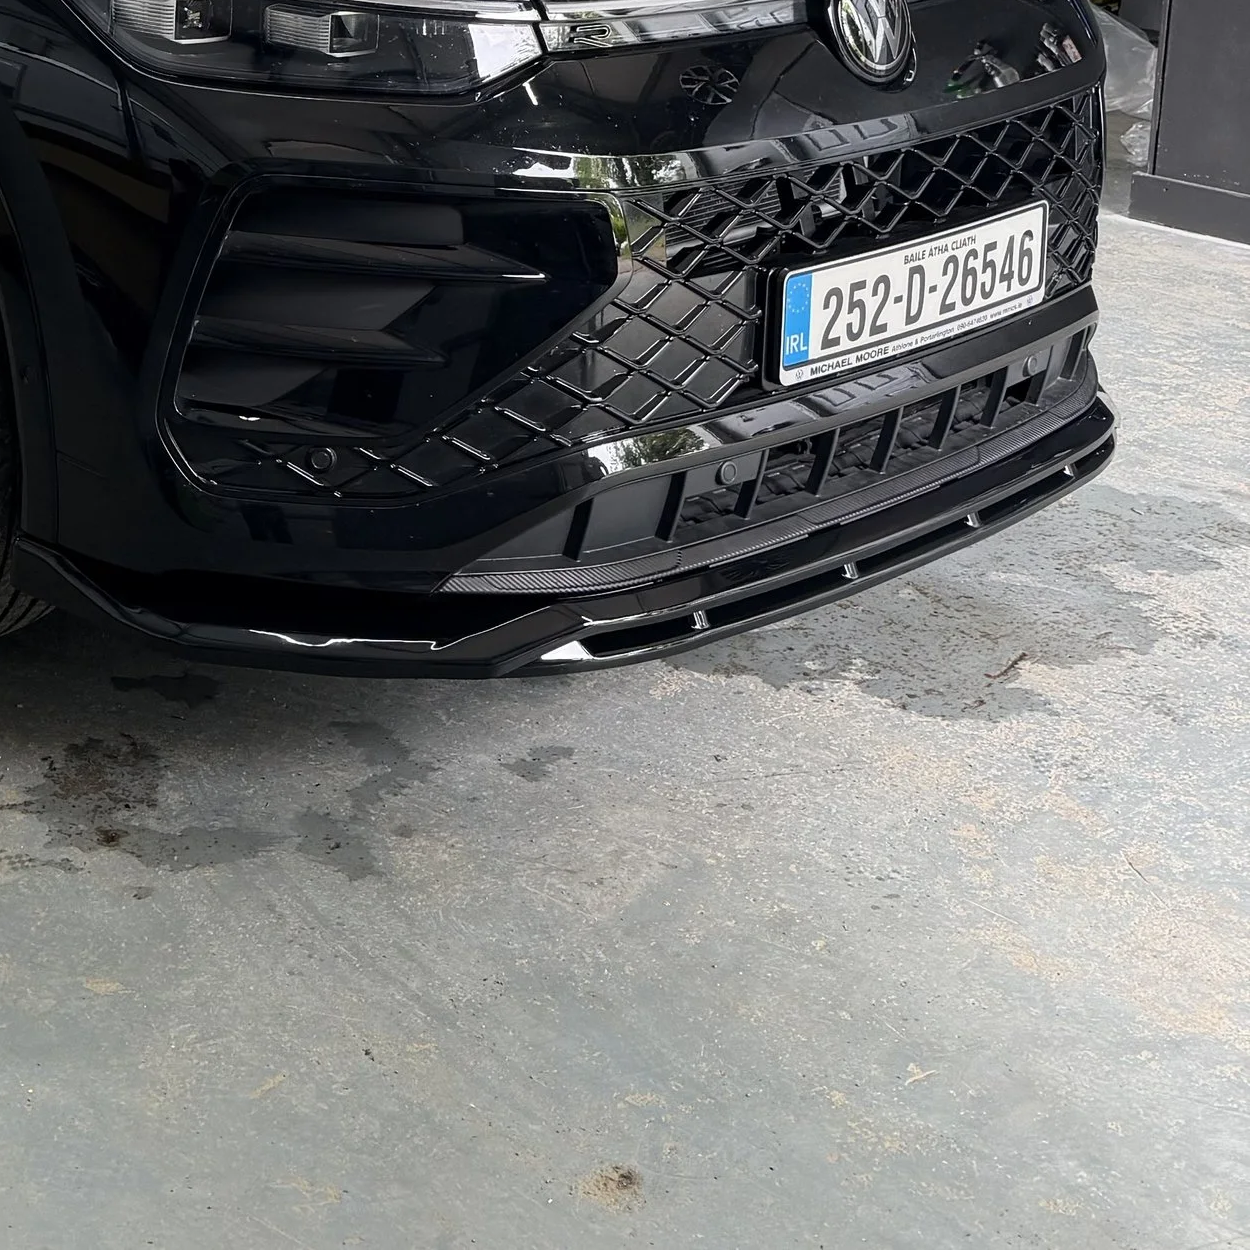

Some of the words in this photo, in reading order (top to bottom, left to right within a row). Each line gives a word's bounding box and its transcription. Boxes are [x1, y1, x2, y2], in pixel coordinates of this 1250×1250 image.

[903, 249, 927, 265] BAILE
[951, 234, 977, 251] CLIATH
[820, 229, 1034, 350] 252-D-26546
[785, 332, 808, 356] IRL
[810, 357, 853, 377] MICHAEL
[855, 346, 890, 364] MOORE
